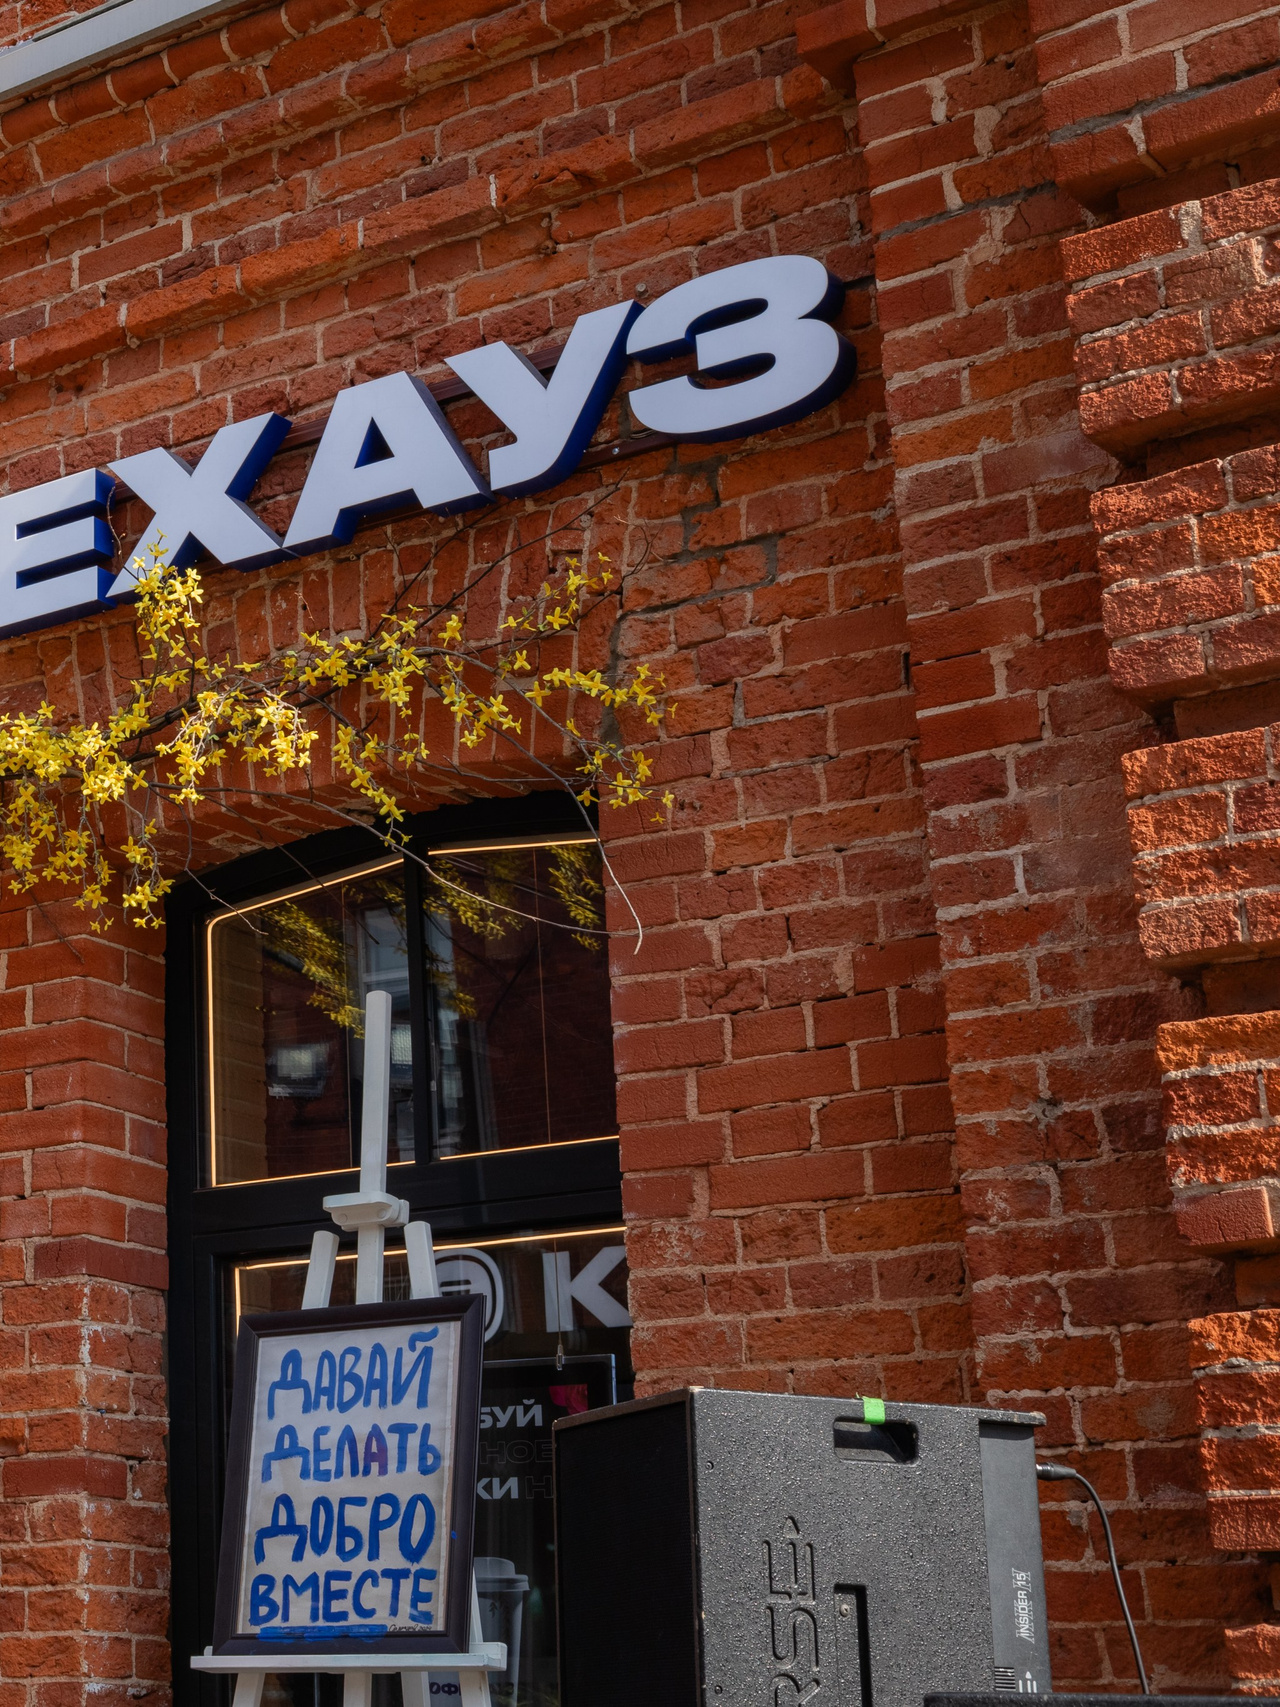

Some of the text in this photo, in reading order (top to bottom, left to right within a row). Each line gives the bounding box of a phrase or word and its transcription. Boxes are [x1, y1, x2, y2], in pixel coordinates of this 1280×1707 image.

[267, 1325, 440, 1420] ДАВАЙ
[261, 1422, 442, 1483] ДЕЛАТЬ
[254, 1492, 437, 1566] ДОБРО
[249, 1568, 438, 1627] ВМЕСТЕ
[1017, 1590, 1030, 1637] INSIDER
